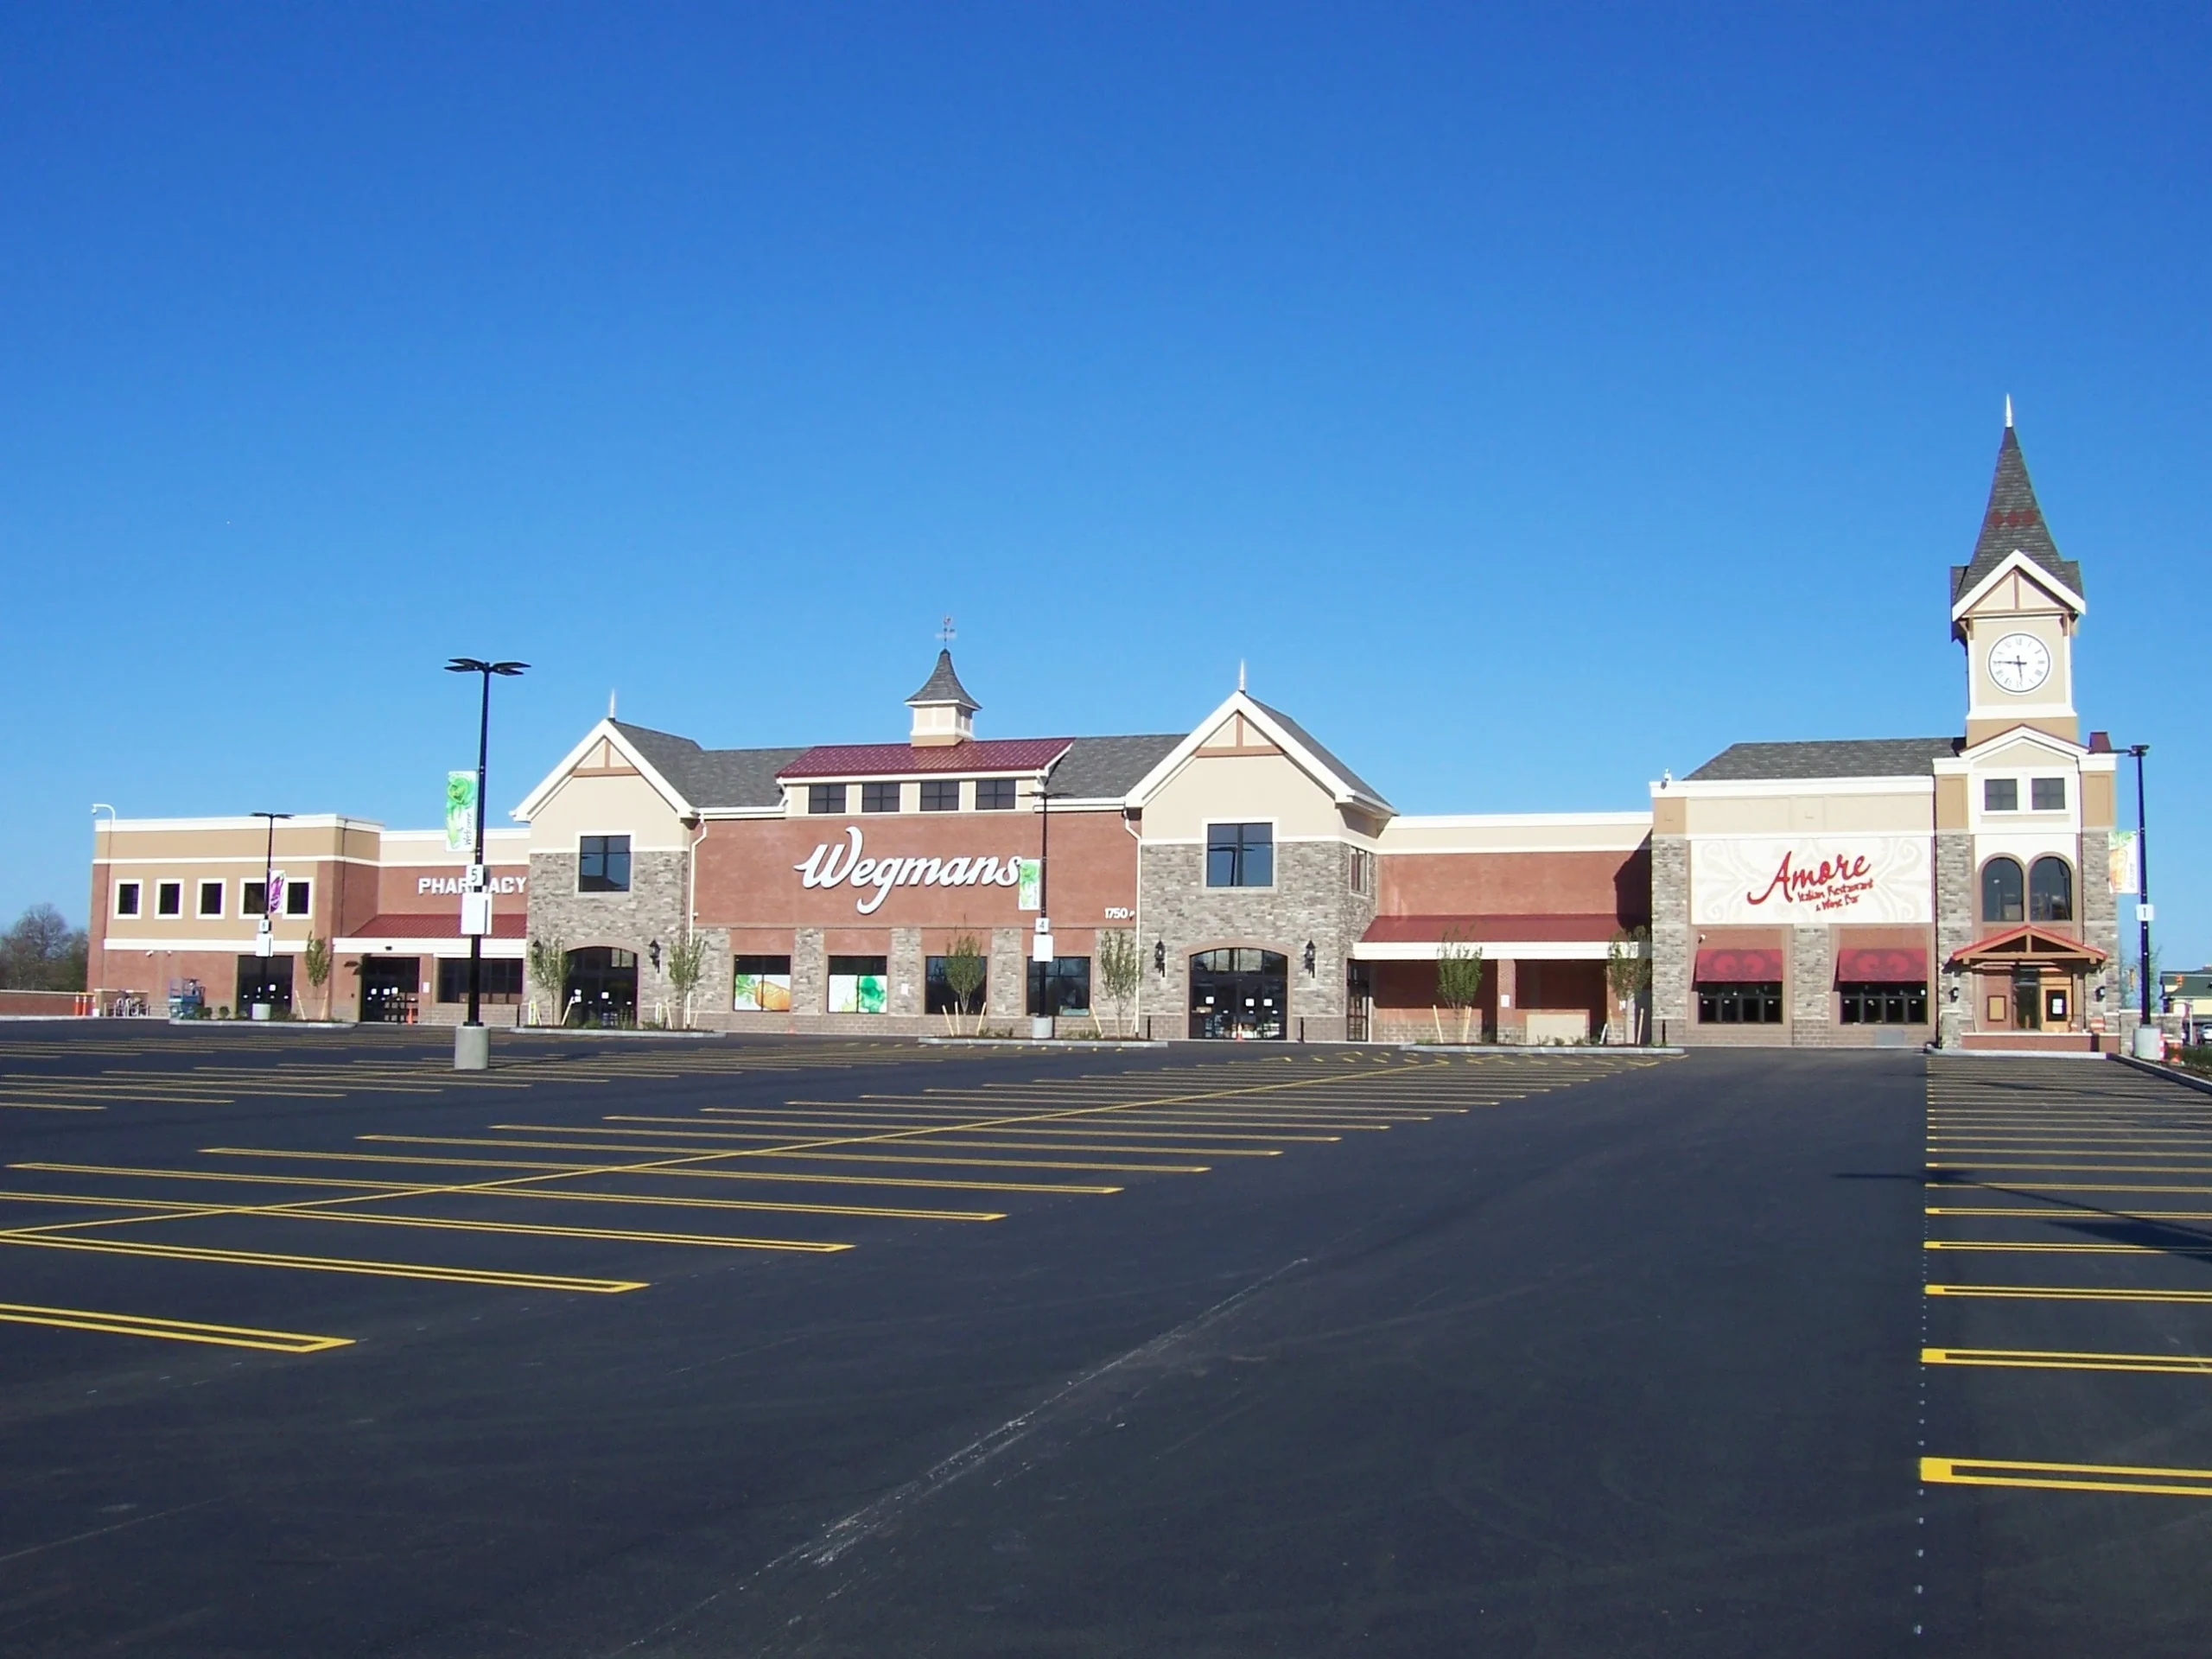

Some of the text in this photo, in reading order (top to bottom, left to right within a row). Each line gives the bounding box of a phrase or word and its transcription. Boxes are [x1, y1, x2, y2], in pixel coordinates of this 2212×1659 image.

[471, 868, 478, 882] 5
[793, 826, 1023, 914] Wegmans
[418, 877, 527, 894] PHARACY
[1746, 850, 1872, 906] Amore
[1104, 907, 1128, 918] 1750
[1039, 920, 1045, 929] 4
